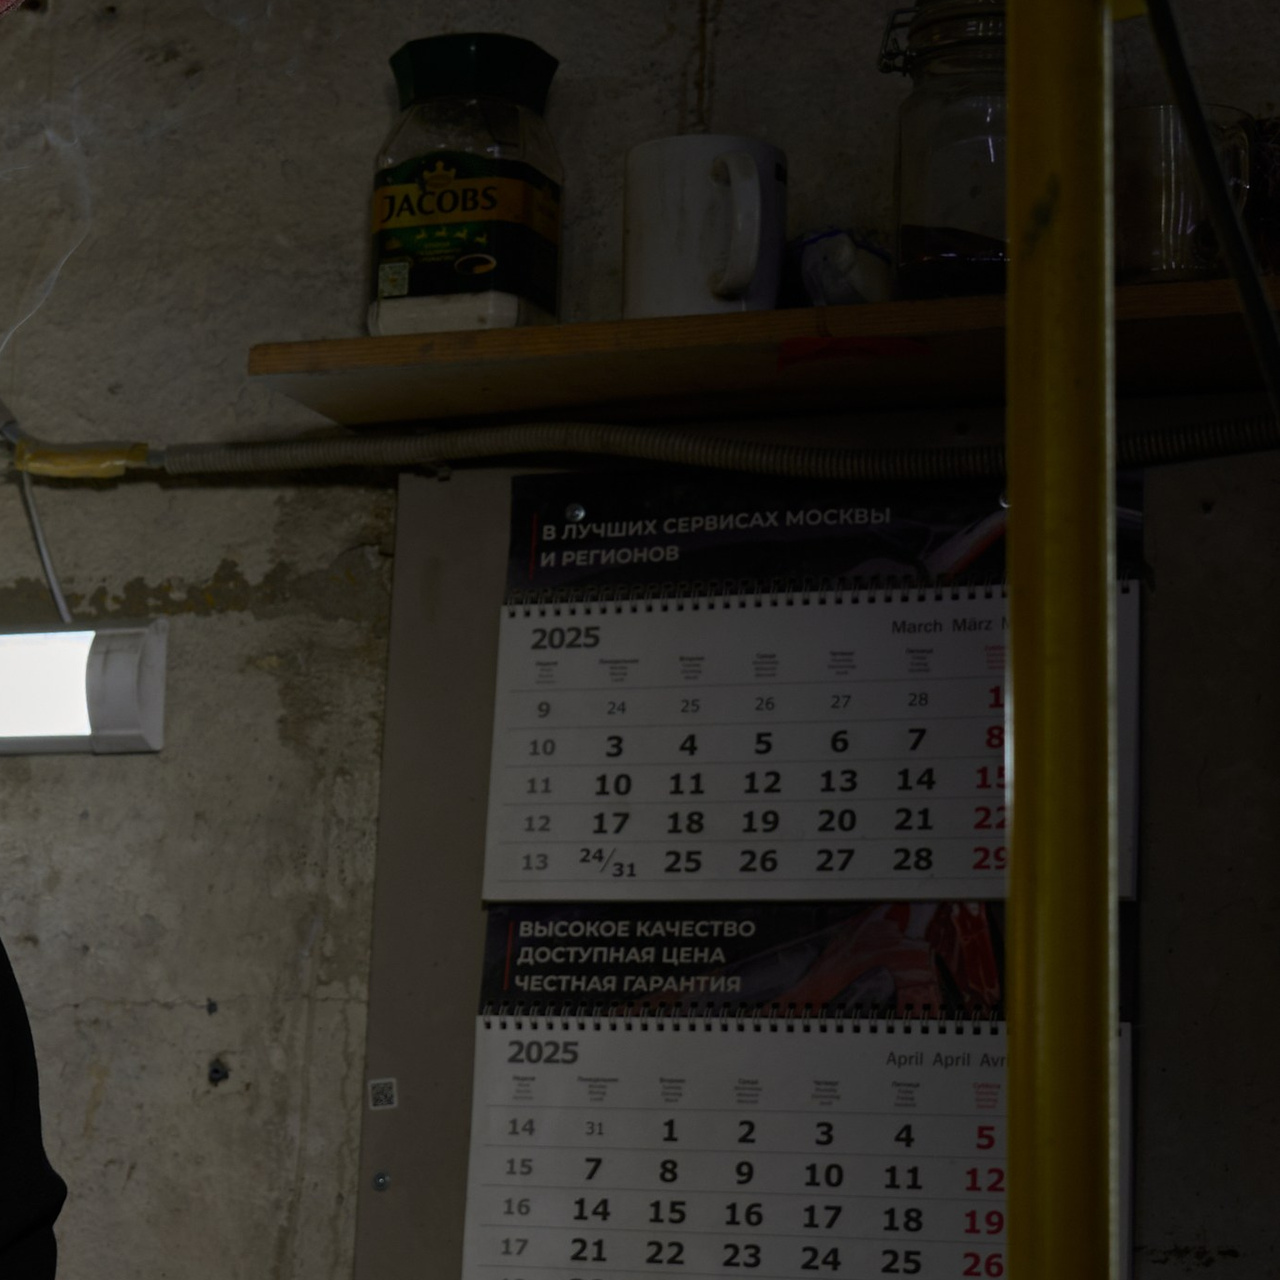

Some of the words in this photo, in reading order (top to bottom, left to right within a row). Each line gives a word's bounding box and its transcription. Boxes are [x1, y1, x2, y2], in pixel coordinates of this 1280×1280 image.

[382, 187, 498, 222] JACOBS
[543, 525, 556, 540] В
[561, 516, 657, 539] ЛУЧШИХ
[663, 511, 778, 534] СЕРВИСАХ
[786, 508, 890, 526] МОСКВЫ
[540, 552, 556, 567] И
[562, 545, 679, 566] РЕГИОНОВ
[531, 626, 600, 650] 2025
[891, 620, 943, 634] March
[952, 617, 993, 632] März
[537, 701, 551, 718] 9
[607, 701, 626, 715] 24
[681, 699, 700, 713] 25
[755, 697, 775, 711] 26
[831, 695, 851, 709] 27
[908, 692, 928, 706] 28
[988, 686, 1003, 709] 1
[530, 739, 556, 756] 10
[606, 735, 623, 757] 3
[679, 734, 698, 756] 4
[755, 732, 772, 755] 5
[831, 730, 849, 753] 6
[909, 728, 926, 750] 7
[986, 726, 1004, 749] 8
[527, 777, 552, 793] 11
[596, 774, 632, 796] 10
[670, 773, 704, 795] 11
[745, 771, 781, 793] 12
[821, 769, 857, 792] 13
[898, 768, 936, 790] 14
[525, 815, 551, 832] 12
[593, 812, 630, 834] 17
[668, 811, 704, 834] 18
[743, 810, 779, 833] 19
[818, 809, 856, 832] 20
[895, 808, 933, 830] 21
[523, 854, 548, 870] 13
[580, 848, 636, 877] 24/31
[665, 850, 702, 873] 25
[740, 849, 778, 872] 26
[816, 849, 855, 871] 27
[893, 847, 933, 871] 28
[972, 847, 1007, 870] 29
[519, 921, 629, 937] ВЫСОКОЕ
[636, 921, 755, 937] КАЧЕСТВО
[517, 947, 655, 965] ДОСТУПНАЯ
[662, 947, 725, 966] ЦЕНА
[515, 975, 616, 991] ЧЕСТНАЯ
[623, 975, 742, 992] ГАРАНТИЯ
[508, 1040, 579, 1064] 2025
[886, 1051, 923, 1068] April
[932, 1052, 970, 1069] April
[508, 1118, 535, 1136] 14
[586, 1121, 604, 1136] 31
[663, 1119, 678, 1142] 1
[738, 1120, 755, 1143] 2
[816, 1122, 833, 1145] 3
[894, 1124, 914, 1147] 4
[977, 1126, 995, 1150] 5
[506, 1158, 533, 1176] 15
[585, 1158, 602, 1180] 7
[660, 1159, 678, 1183] 8
[736, 1161, 754, 1185] 9
[805, 1163, 844, 1187] 10
[885, 1166, 922, 1190] 11
[965, 1167, 1005, 1192] 12
[504, 1198, 530, 1216] 16
[574, 1198, 610, 1221] 14
[649, 1200, 686, 1224] 15
[726, 1202, 763, 1226] 16
[804, 1205, 842, 1229] 17
[884, 1208, 923, 1232] 18
[965, 1210, 1004, 1235] 19
[501, 1238, 528, 1255] 17
[571, 1238, 607, 1262] 21
[646, 1241, 684, 1264] 22
[723, 1243, 761, 1268] 23
[801, 1246, 841, 1271] 24
[882, 1249, 921, 1274] 25
[963, 1252, 1004, 1278] 26
